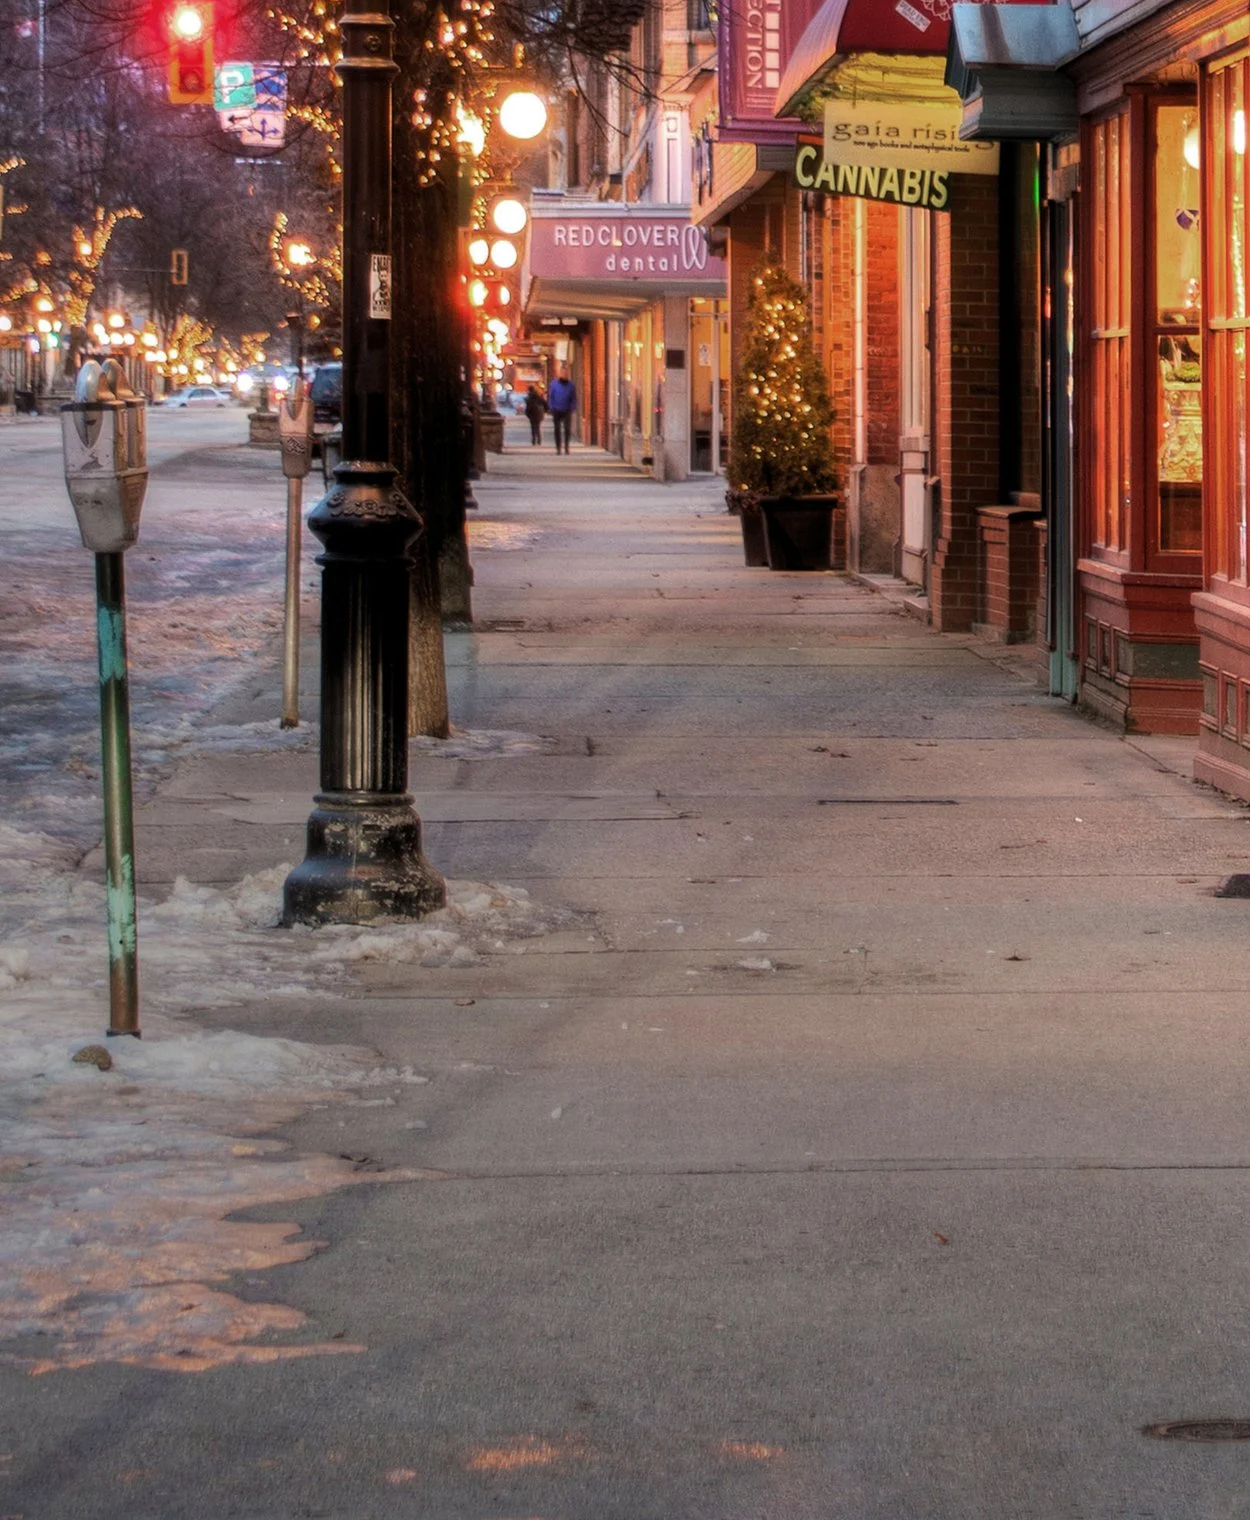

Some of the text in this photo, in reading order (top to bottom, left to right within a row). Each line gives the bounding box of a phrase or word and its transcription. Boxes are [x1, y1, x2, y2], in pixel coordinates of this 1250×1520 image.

[832, 120, 901, 142] gaia
[795, 145, 949, 209] CANNABIS
[605, 253, 678, 272] dental
